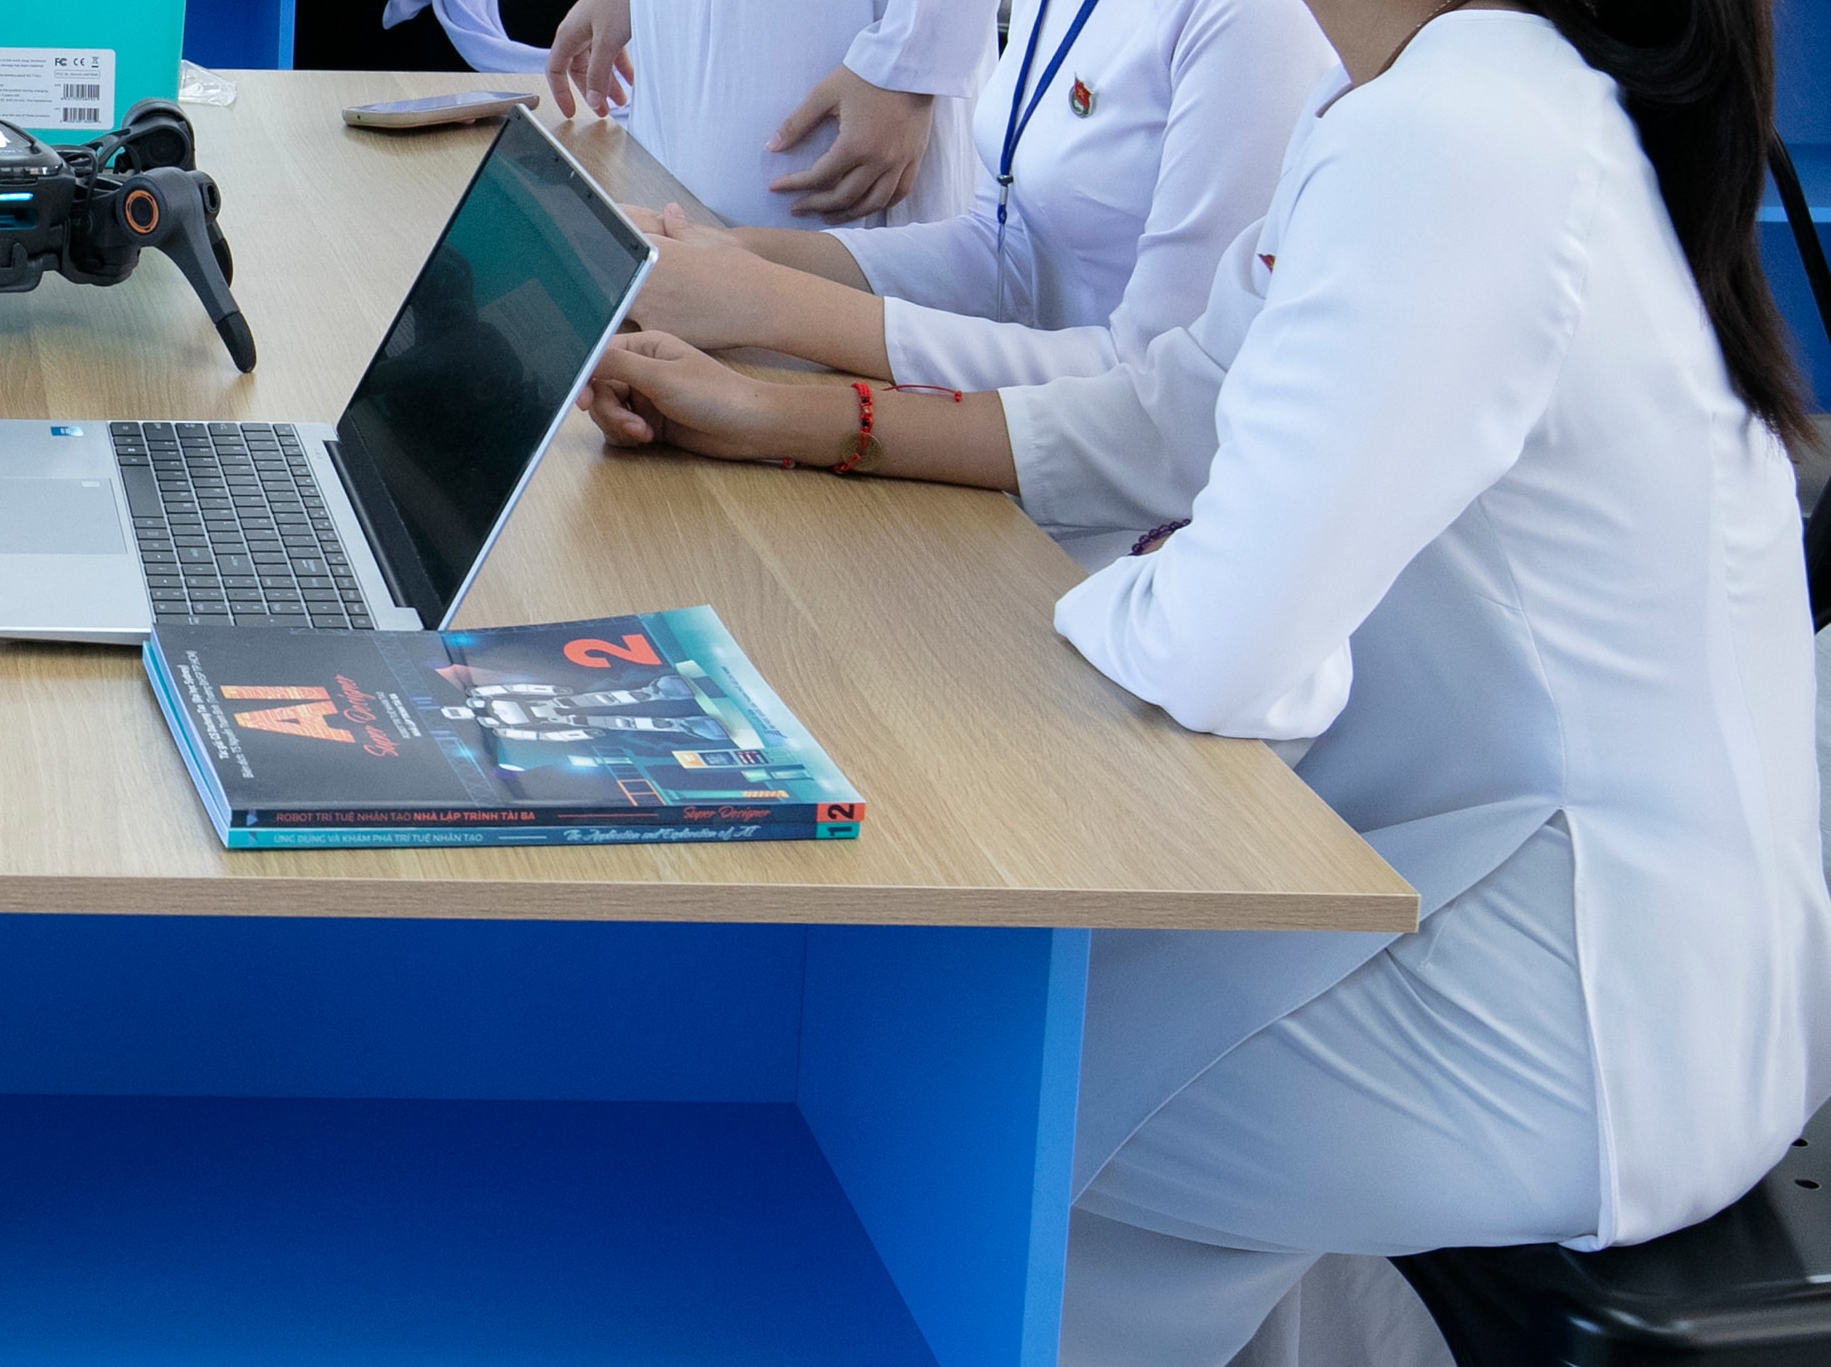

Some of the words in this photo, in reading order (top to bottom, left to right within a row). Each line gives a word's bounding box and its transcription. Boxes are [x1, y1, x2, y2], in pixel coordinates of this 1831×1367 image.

[563, 634, 662, 668] 2
[335, 674, 376, 722] Designer
[220, 685, 356, 743] AI
[363, 725, 399, 756] Super
[276, 813, 313, 822] ROBOT
[315, 811, 332, 822] TRÍ
[357, 810, 390, 822] NHÂN
[413, 810, 438, 821] NHÀ
[440, 809, 462, 823] LẬP
[464, 809, 498, 821] TRÌNH
[499, 809, 519, 821] TÀI
[682, 805, 716, 821] Super
[717, 805, 771, 821] Designer
[827, 803, 855, 819] 2
